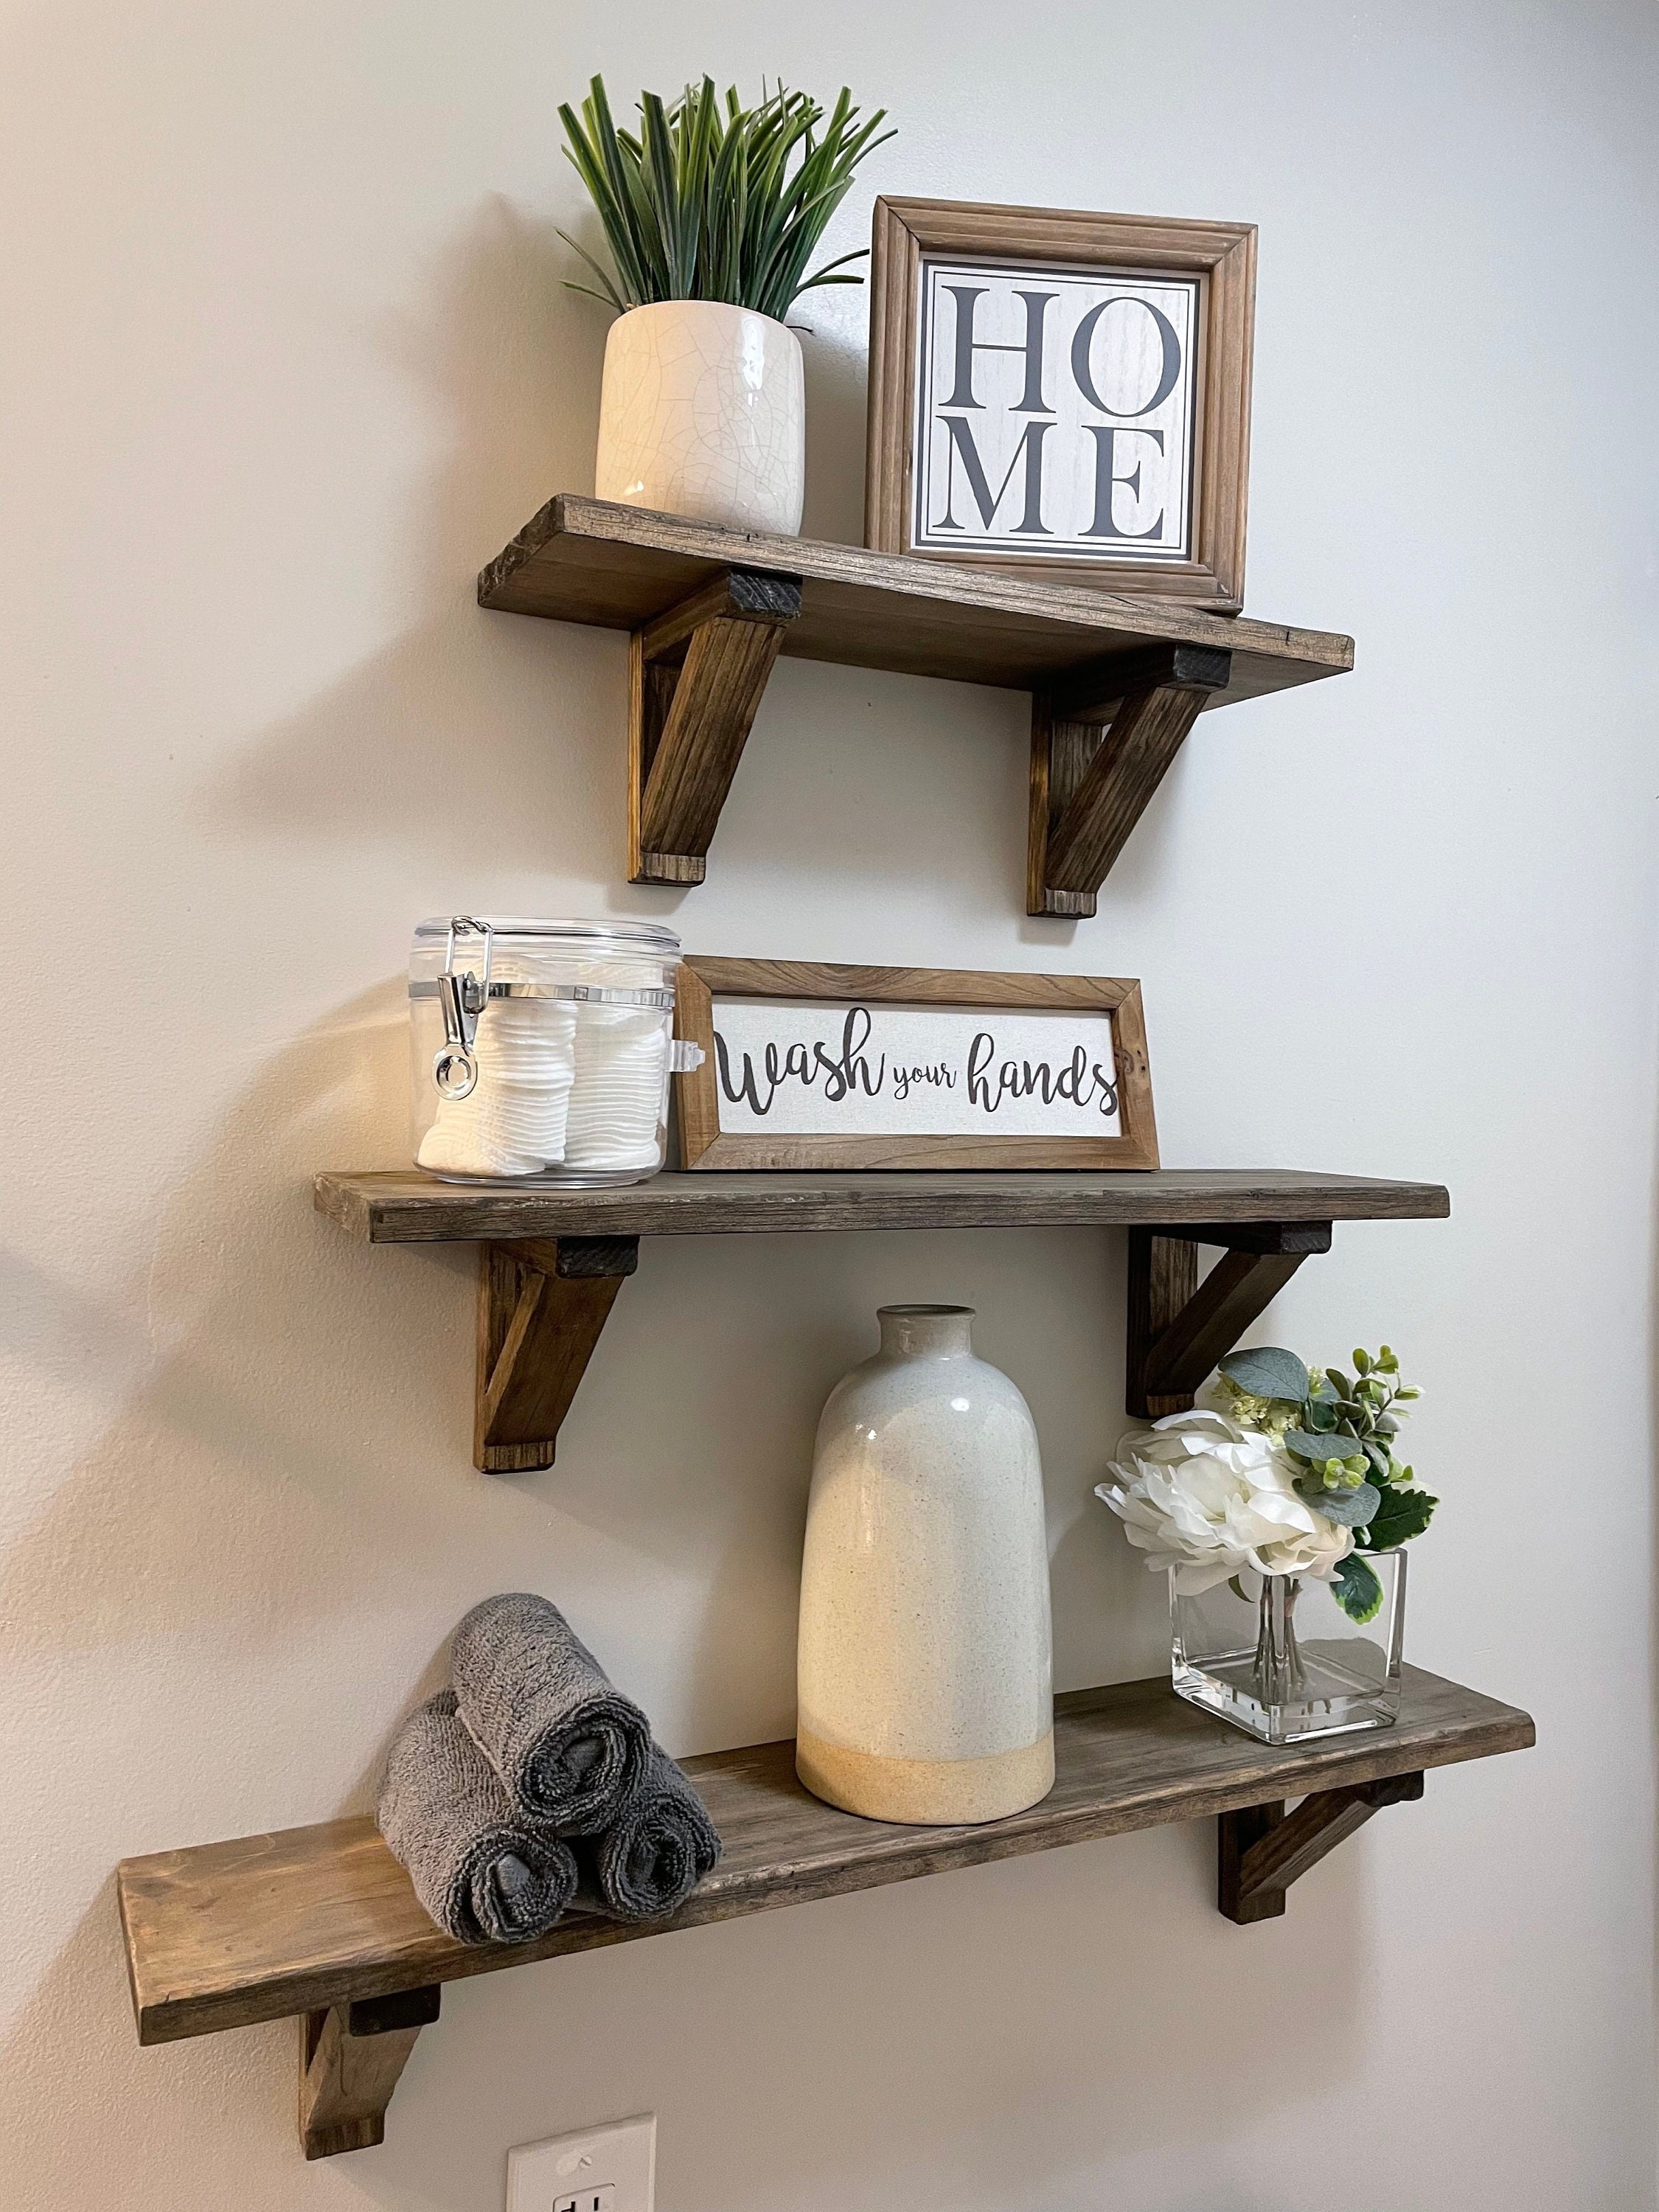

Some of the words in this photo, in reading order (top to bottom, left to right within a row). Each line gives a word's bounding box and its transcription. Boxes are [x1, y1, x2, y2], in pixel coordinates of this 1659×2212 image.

[713, 1006, 886, 1116] Wash
[893, 1060, 961, 1100] your
[967, 1032, 1119, 1116] hands
